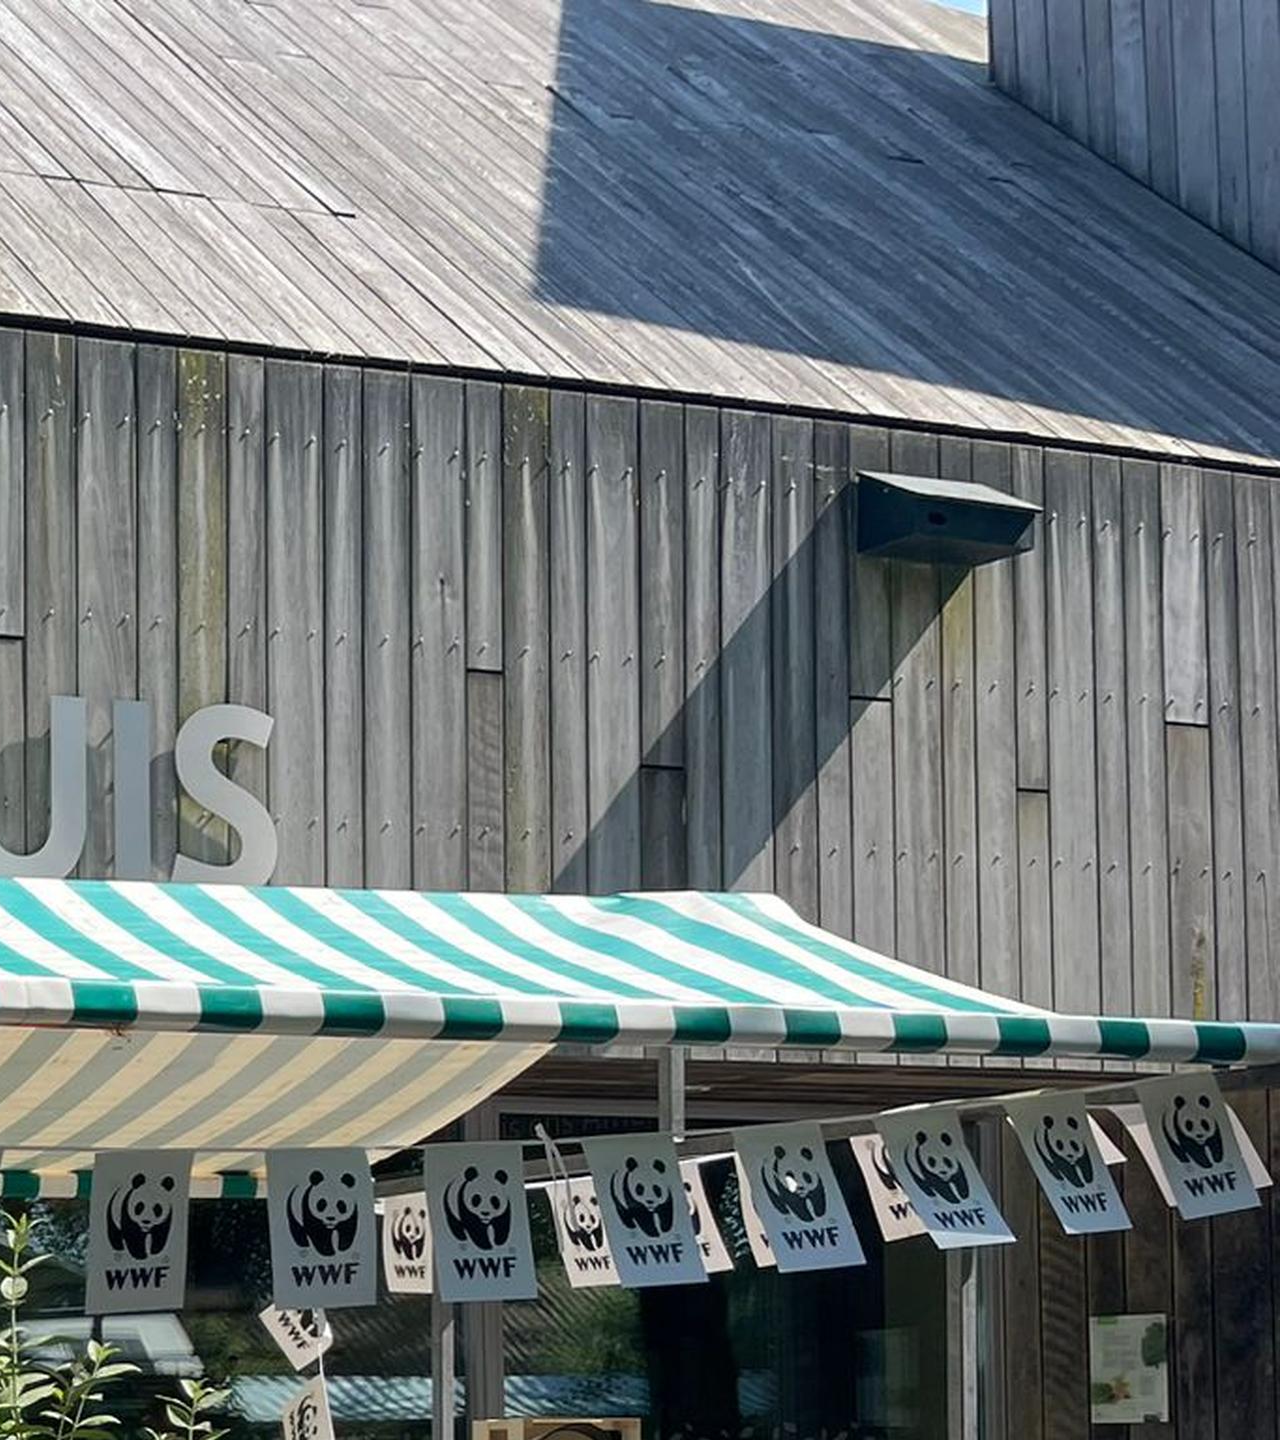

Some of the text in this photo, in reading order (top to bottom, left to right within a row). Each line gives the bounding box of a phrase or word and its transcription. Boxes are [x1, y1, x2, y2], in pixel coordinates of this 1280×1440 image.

[1184, 1176, 1237, 1199] WWF
[1060, 1192, 1108, 1214] WWF
[934, 1207, 986, 1229] WWF
[782, 1226, 840, 1250] WWF
[574, 1256, 611, 1271] WWF
[626, 1242, 684, 1266] WWF
[105, 1265, 170, 1290] WWF
[291, 1262, 358, 1287] WWF
[394, 1265, 426, 1279] WWF
[453, 1256, 517, 1279] WWF
[278, 1312, 310, 1350] WWF
